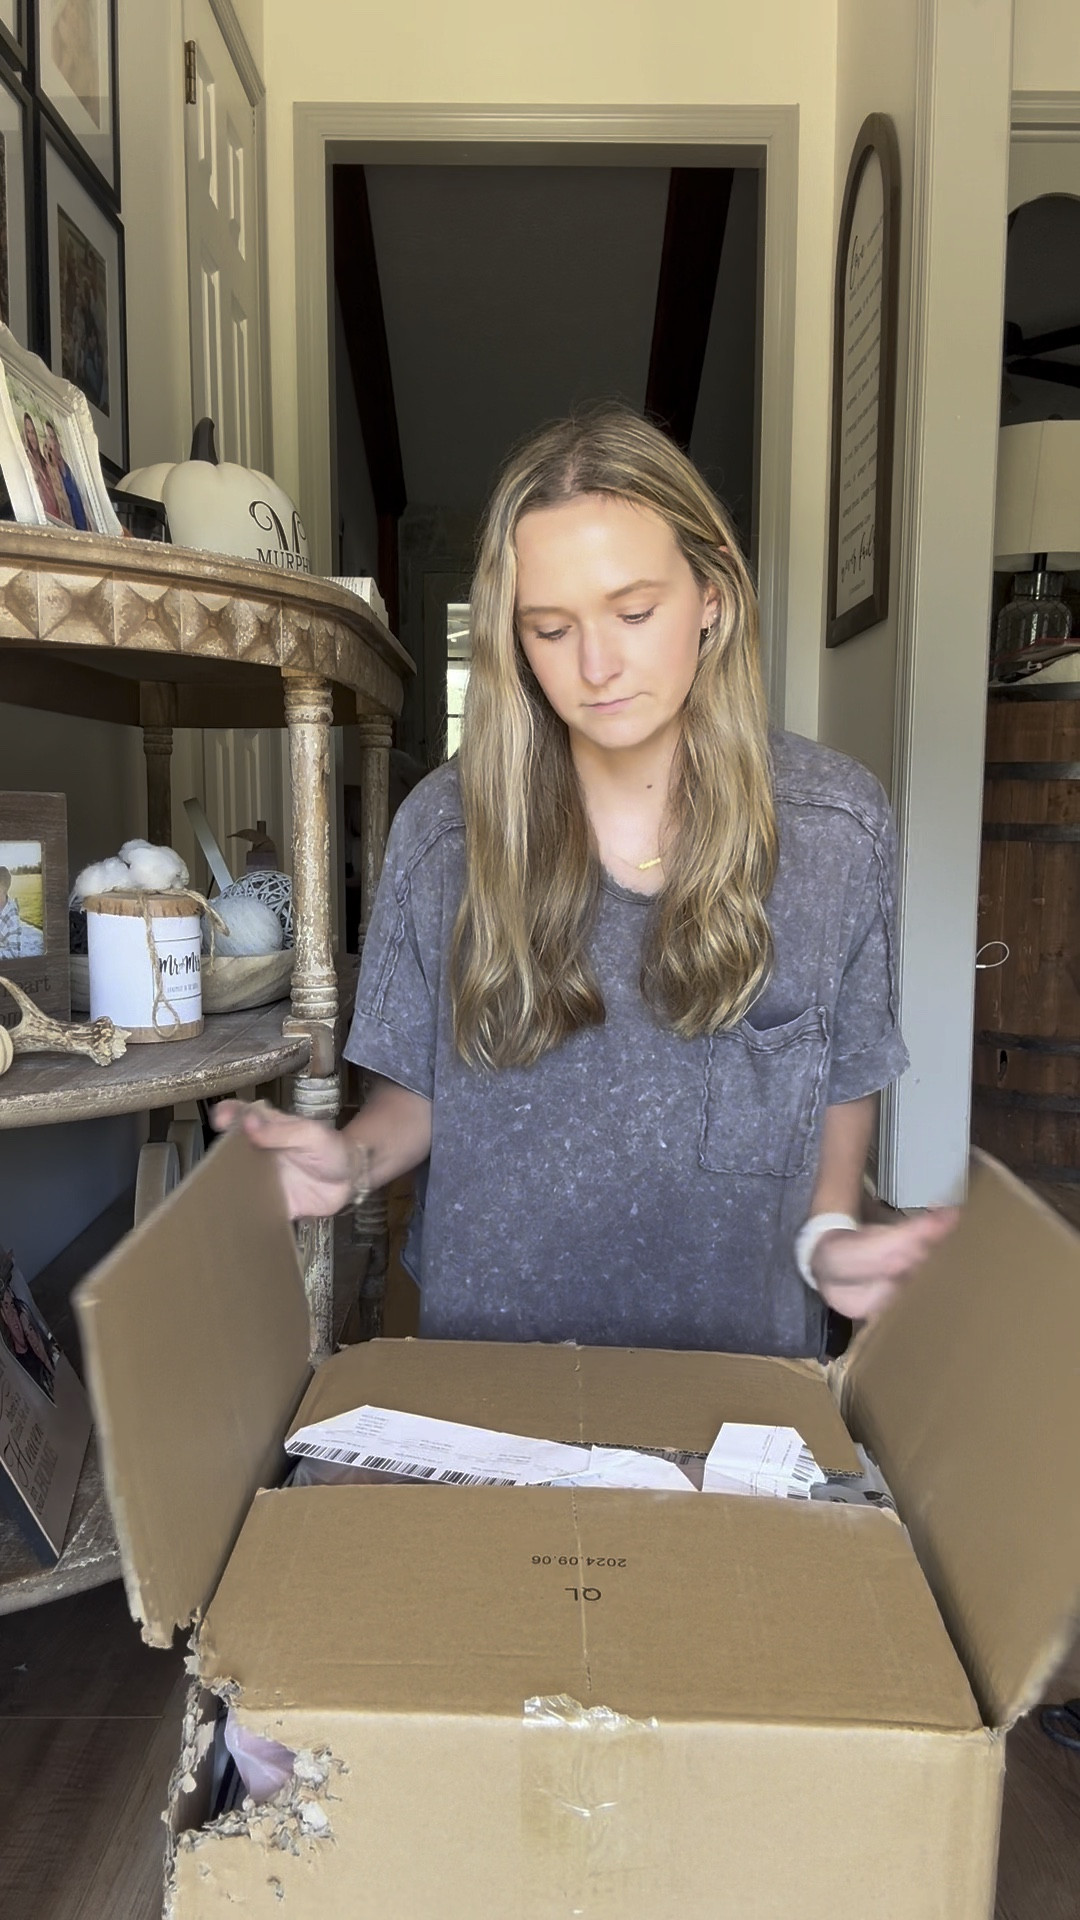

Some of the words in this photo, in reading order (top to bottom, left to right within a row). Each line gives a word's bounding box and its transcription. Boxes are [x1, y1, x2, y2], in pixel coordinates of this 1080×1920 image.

[159, 954, 179, 976] Mr
[531, 1555, 627, 1568] 2024.09.06
[564, 1586, 602, 1601] QL
